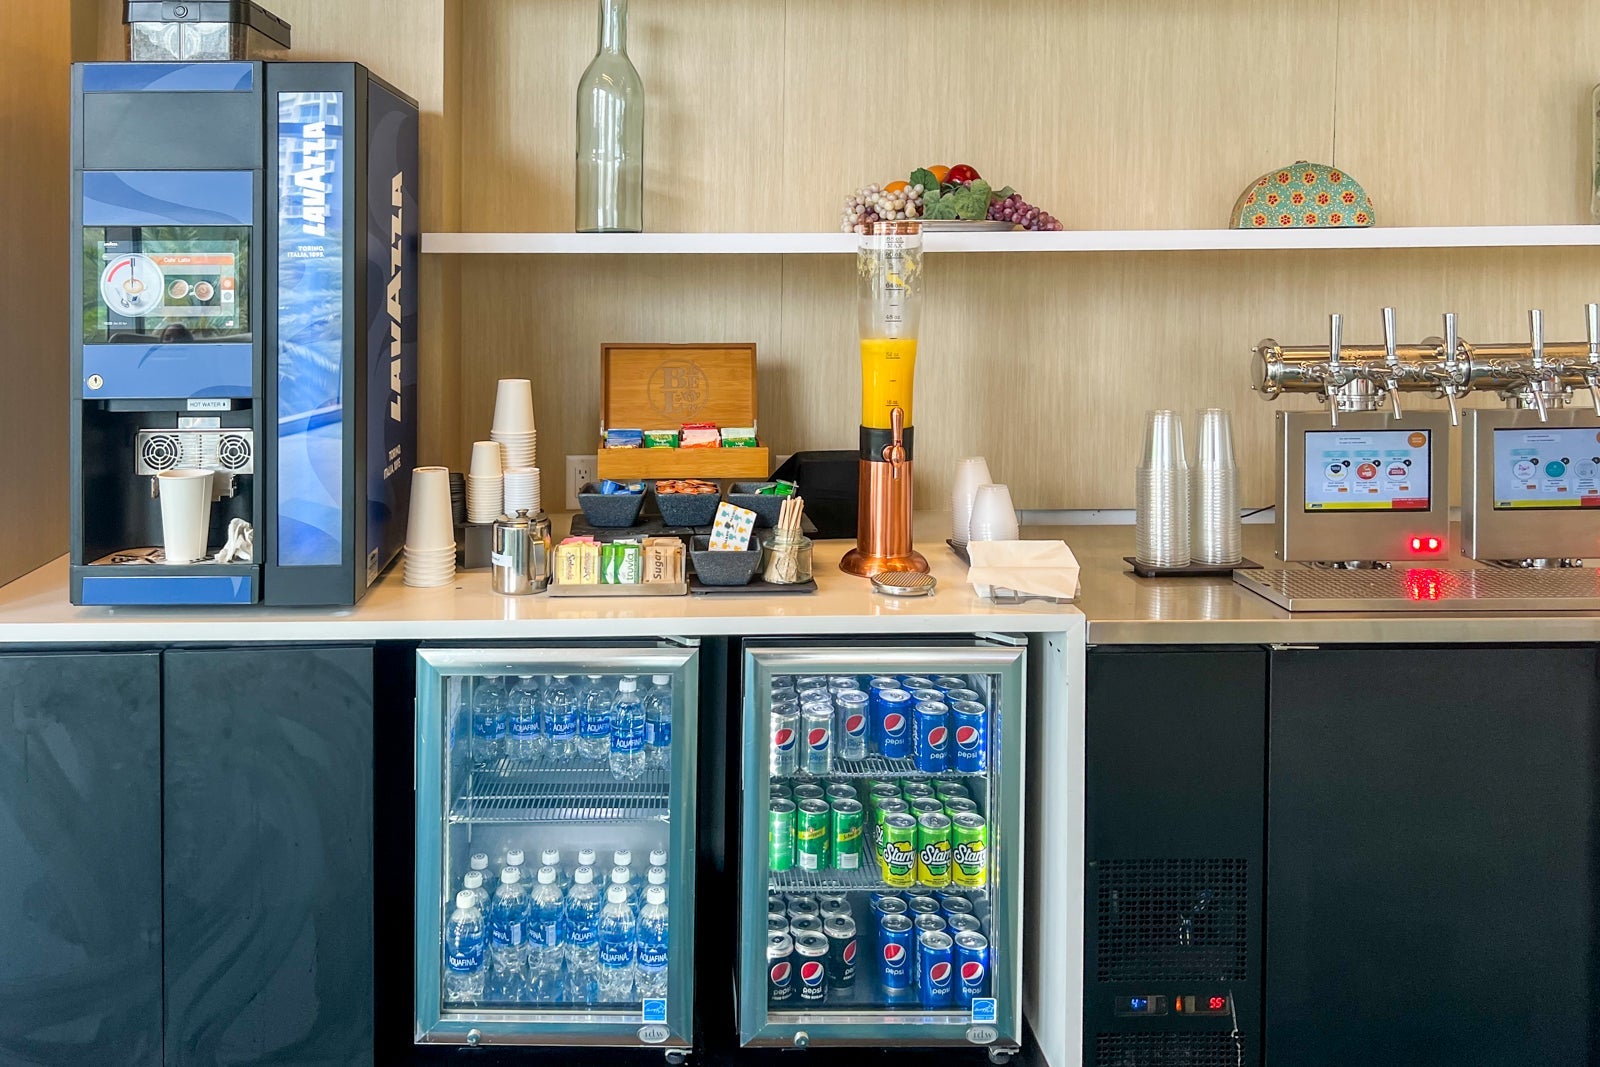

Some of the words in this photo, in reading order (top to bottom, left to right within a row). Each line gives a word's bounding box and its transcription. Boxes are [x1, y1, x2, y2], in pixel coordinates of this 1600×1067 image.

[295, 121, 325, 237] LAVAZZA
[387, 171, 403, 422] LAVAZZA
[653, 550, 663, 579] Sugar
[957, 750, 978, 759] pepsi
[449, 955, 478, 967] AQUAFINA
[601, 951, 629, 962] AQUAFINA
[802, 986, 822, 994] pepsi
